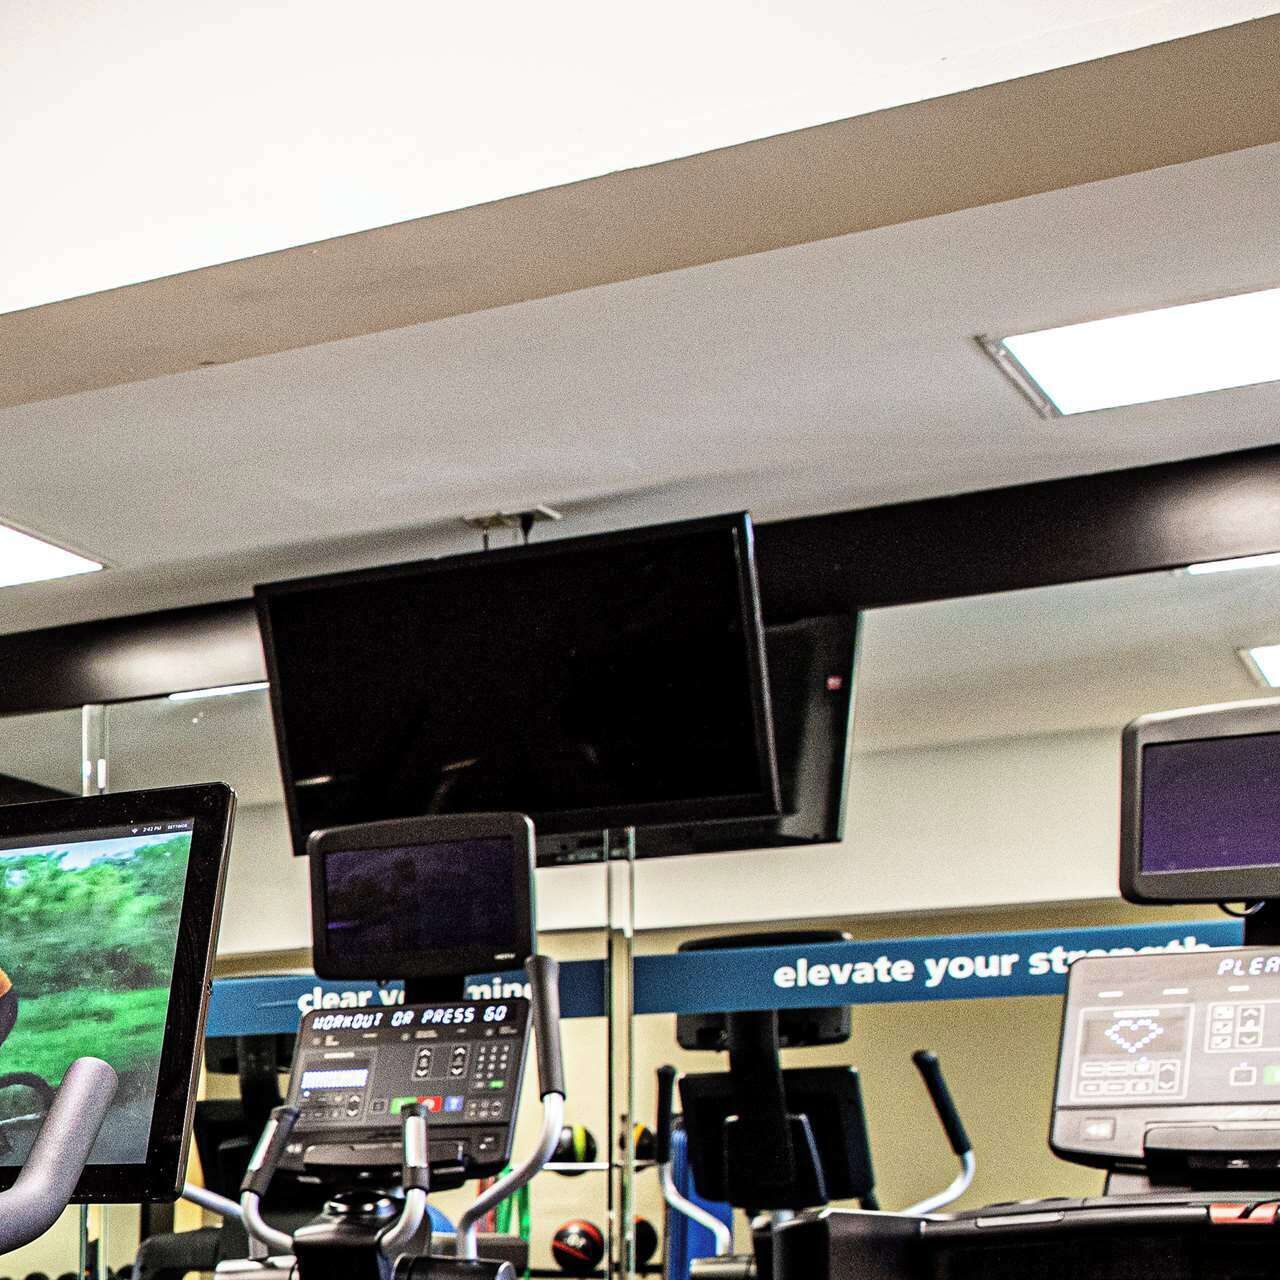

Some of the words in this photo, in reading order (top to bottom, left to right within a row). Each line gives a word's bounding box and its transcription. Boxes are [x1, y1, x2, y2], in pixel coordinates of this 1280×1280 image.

[773, 958, 914, 988] elevate
[924, 951, 1020, 987] your
[297, 986, 373, 1012] clear
[312, 1012, 383, 1030] WORKOUT
[391, 1010, 415, 1027] OR
[421, 1008, 475, 1025] PRESS
